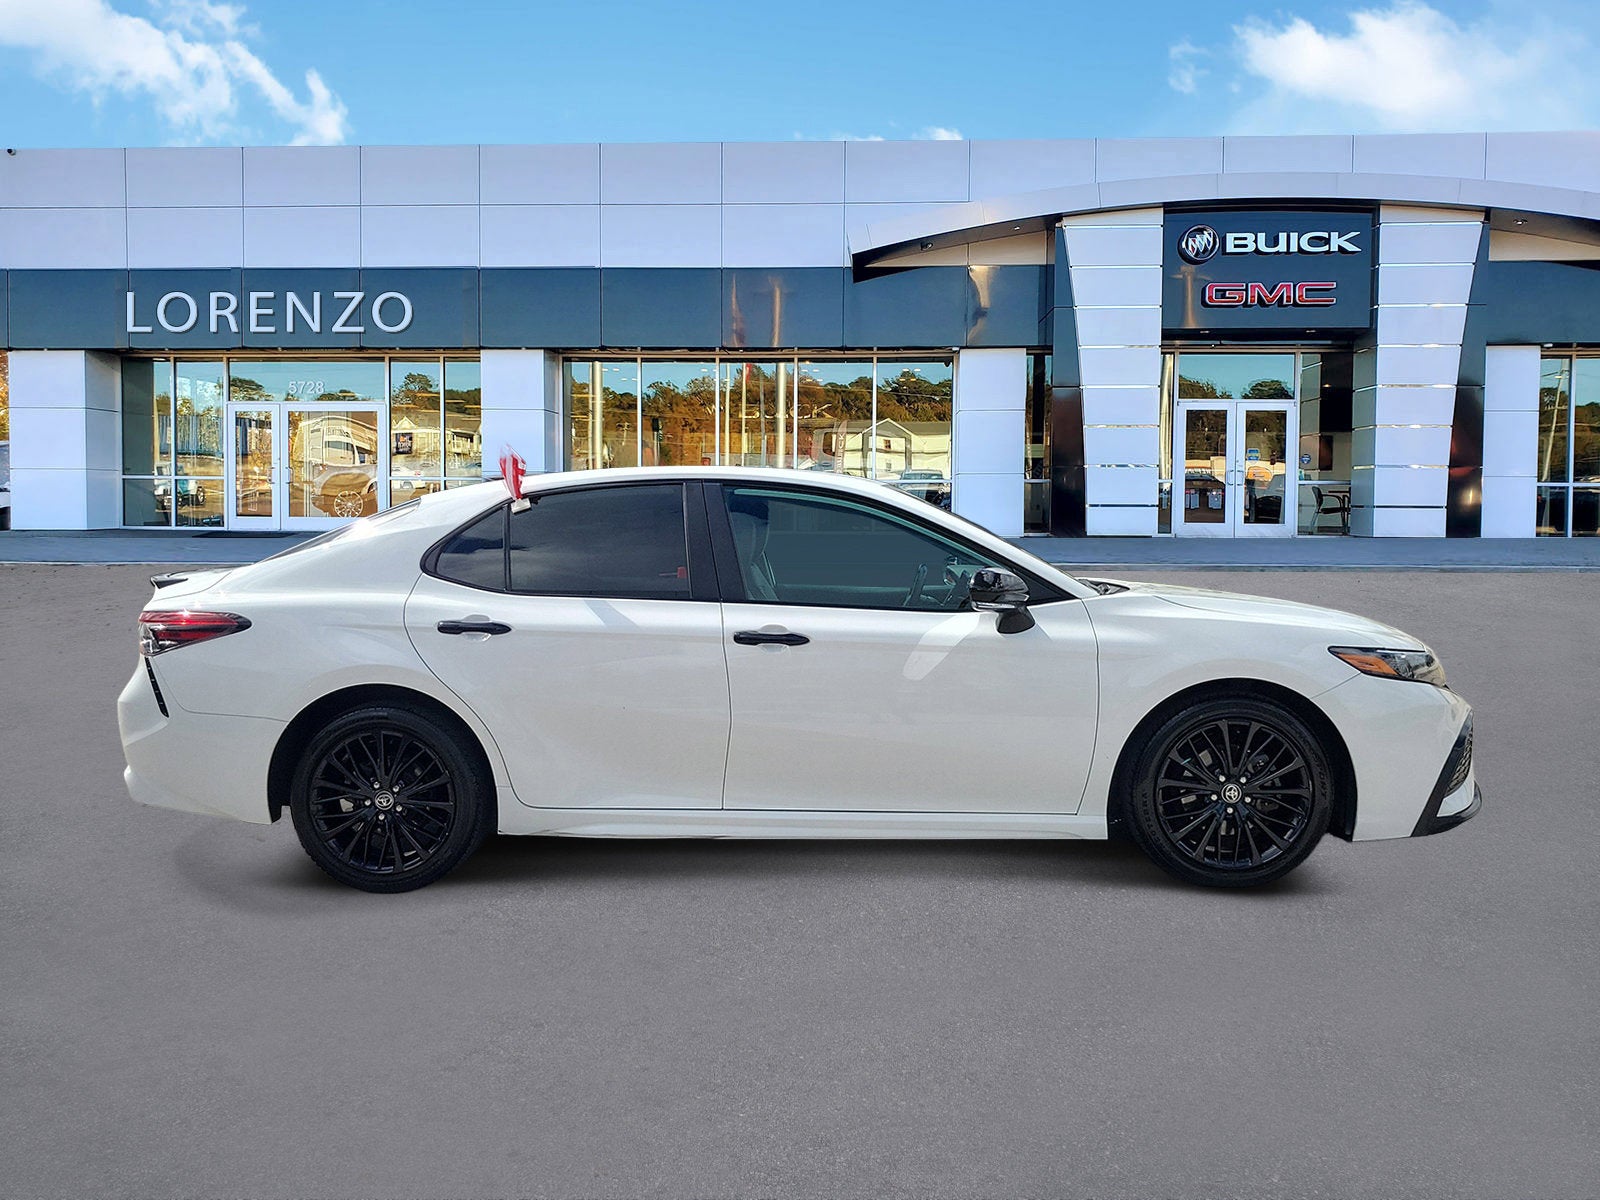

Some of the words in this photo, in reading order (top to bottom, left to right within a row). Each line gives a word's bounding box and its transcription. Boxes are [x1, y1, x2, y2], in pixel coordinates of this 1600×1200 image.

[1225, 231, 1362, 253] BUICK
[1206, 282, 1337, 305] GMC
[126, 291, 414, 333] LORENZO
[288, 381, 325, 394] 5728
